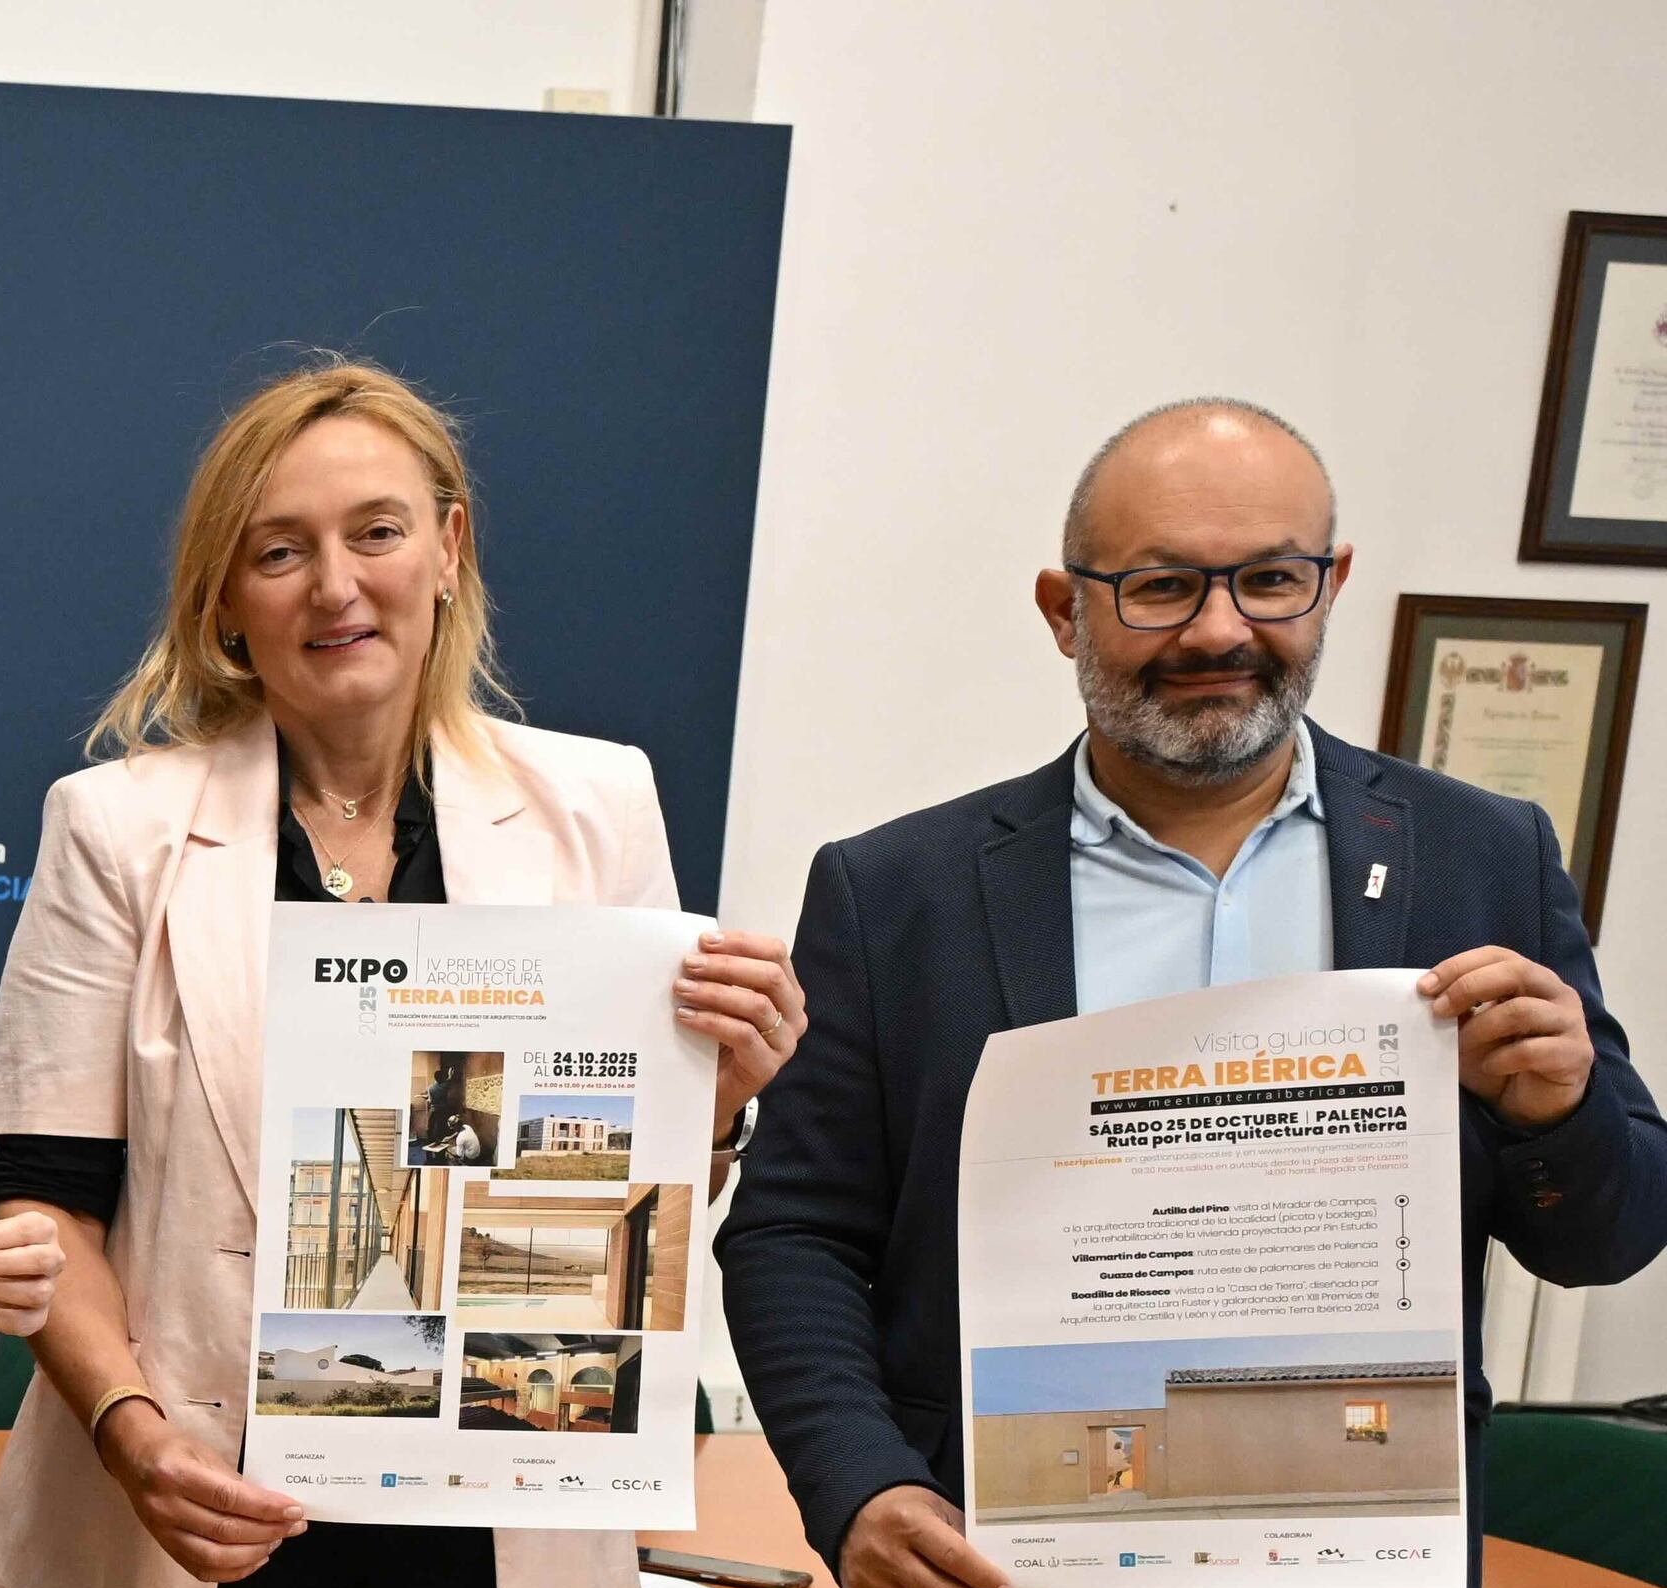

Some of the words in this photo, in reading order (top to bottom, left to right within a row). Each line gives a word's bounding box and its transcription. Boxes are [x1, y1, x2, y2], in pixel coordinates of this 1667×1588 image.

[315, 958, 408, 983] EXPO
[427, 958, 441, 971] IV
[447, 959, 515, 972] PREMIOS
[522, 959, 541, 972] DE
[427, 972, 543, 986] ARQUITECTURA
[387, 989, 455, 1004] TERRA
[460, 984, 544, 1005] IBÉRICA
[359, 986, 376, 1034] 2025
[1193, 1032, 1259, 1053] Visita
[1267, 1024, 1365, 1056] guiada
[1379, 1024, 1399, 1075] 2025
[524, 1052, 548, 1063] DEL
[553, 1052, 637, 1064] 24.10.2025
[534, 1065, 549, 1076] AL
[553, 1065, 636, 1077] 05.12.2025
[1091, 1064, 1206, 1095] TERRA
[1215, 1051, 1366, 1085] IBÉRICA
[1090, 1121, 1162, 1136] SÁBADO
[1167, 1119, 1189, 1132] 25
[1188, 1118, 1211, 1132] DE
[1216, 1112, 1298, 1129] OCTUBRE
[1316, 1106, 1406, 1123] PALENCIA
[1108, 1135, 1148, 1147] Ruta
[1153, 1135, 1182, 1148] por
[1186, 1131, 1201, 1142] la
[1206, 1126, 1323, 1144] arquitectura
[1328, 1125, 1350, 1134] en
[1354, 1121, 1406, 1133] tierra
[286, 1475, 313, 1484] COAL
[1015, 1559, 1045, 1568] COAL
